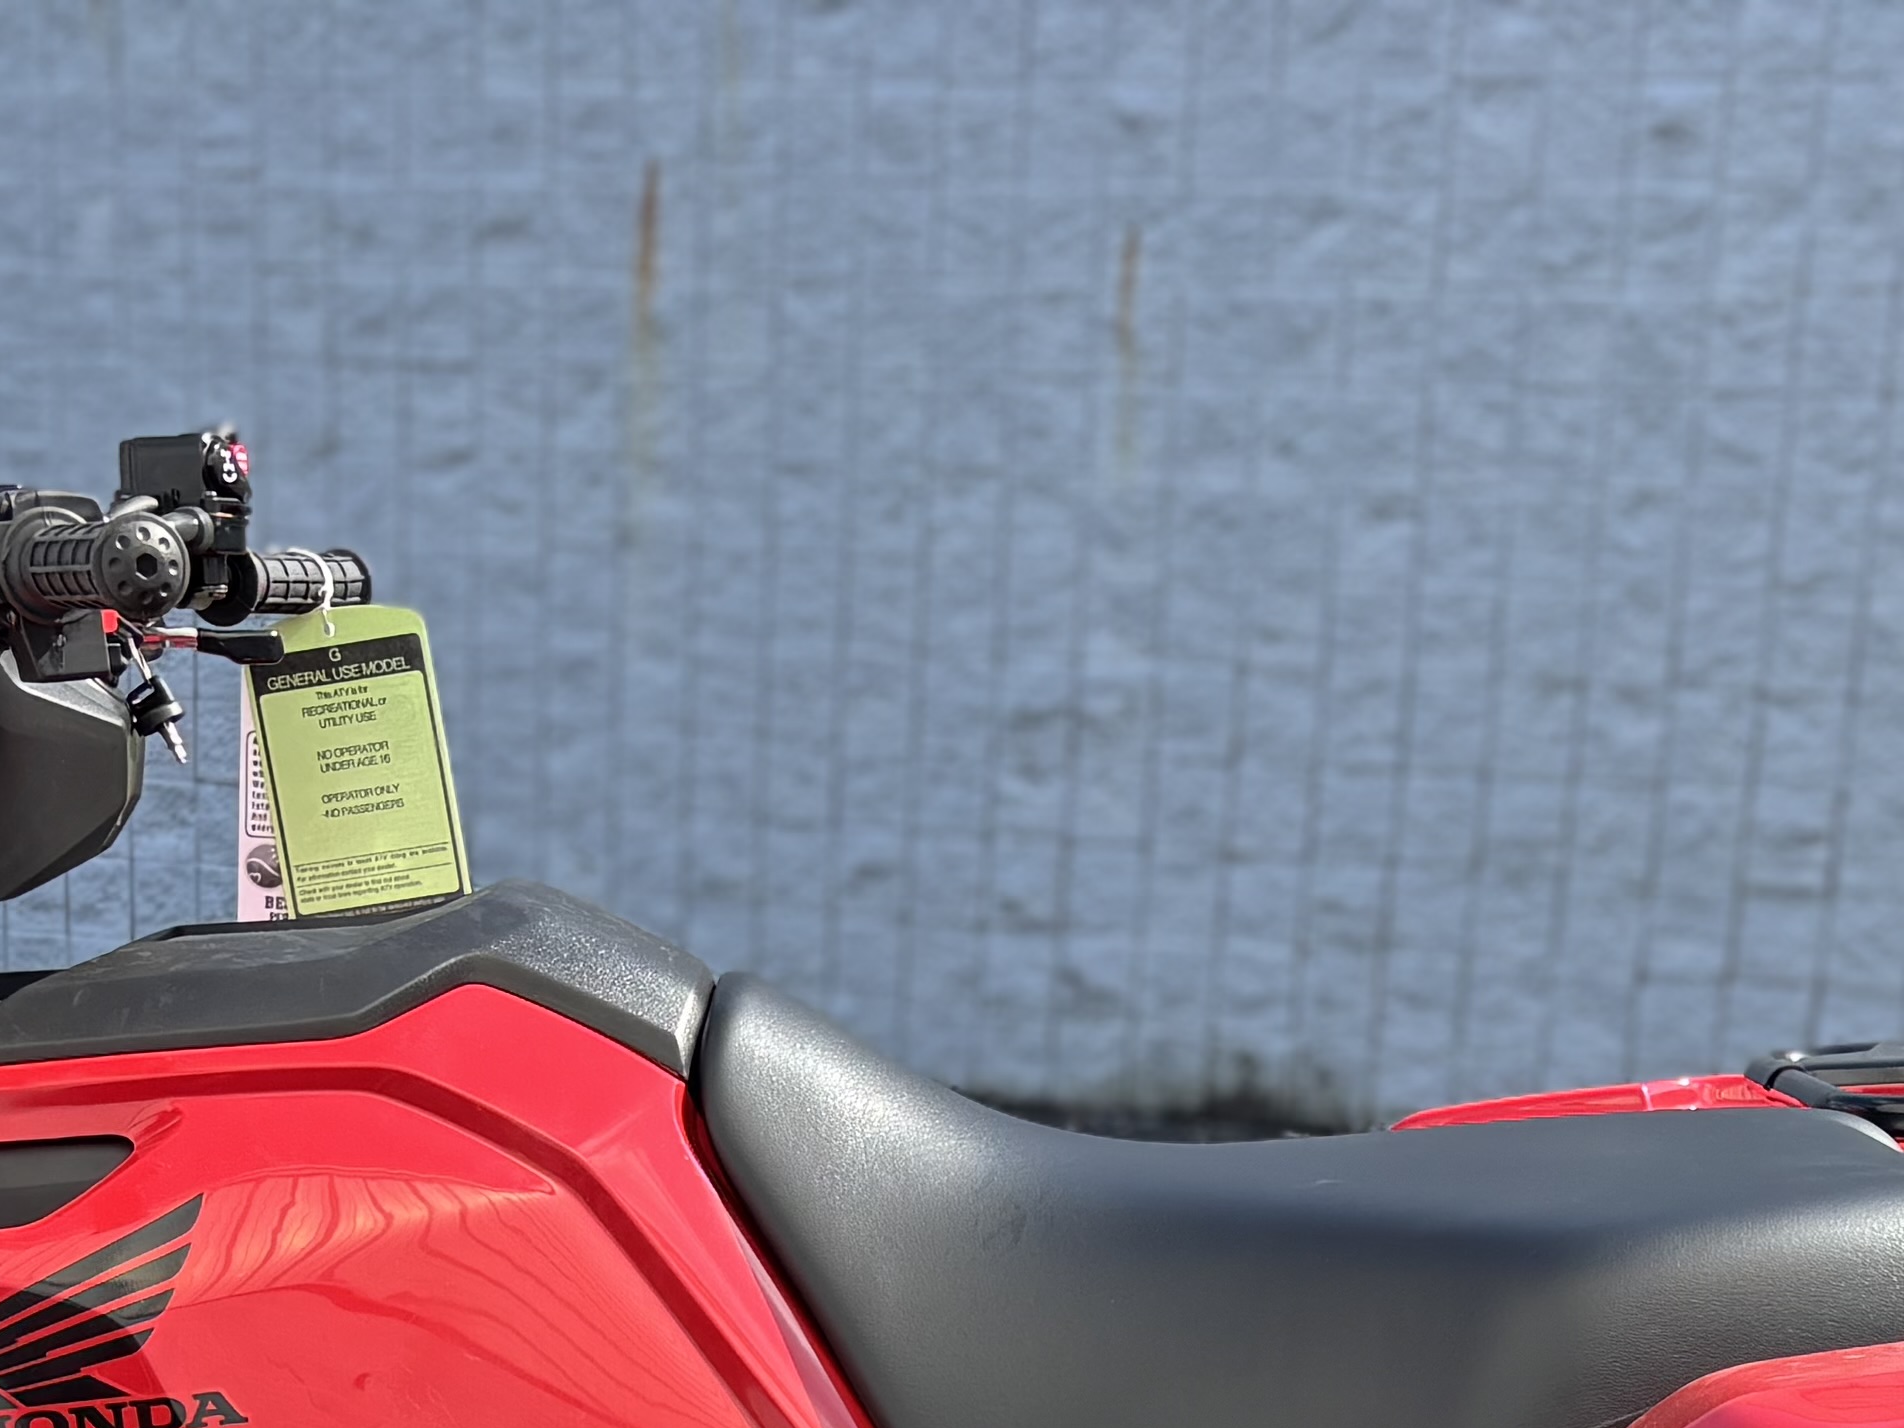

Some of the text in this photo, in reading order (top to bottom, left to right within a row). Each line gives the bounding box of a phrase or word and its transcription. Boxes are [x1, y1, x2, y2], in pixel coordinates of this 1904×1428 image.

[328, 647, 342, 662] G
[267, 656, 412, 691] GENERAL USE MODEL
[301, 699, 378, 718] RECREATIONAL
[318, 710, 377, 729] UTILITY USE
[317, 740, 390, 761] NO OPERATOR
[320, 753, 391, 773] UNDER AGE 16
[321, 783, 400, 804] OPERATOR ONLY
